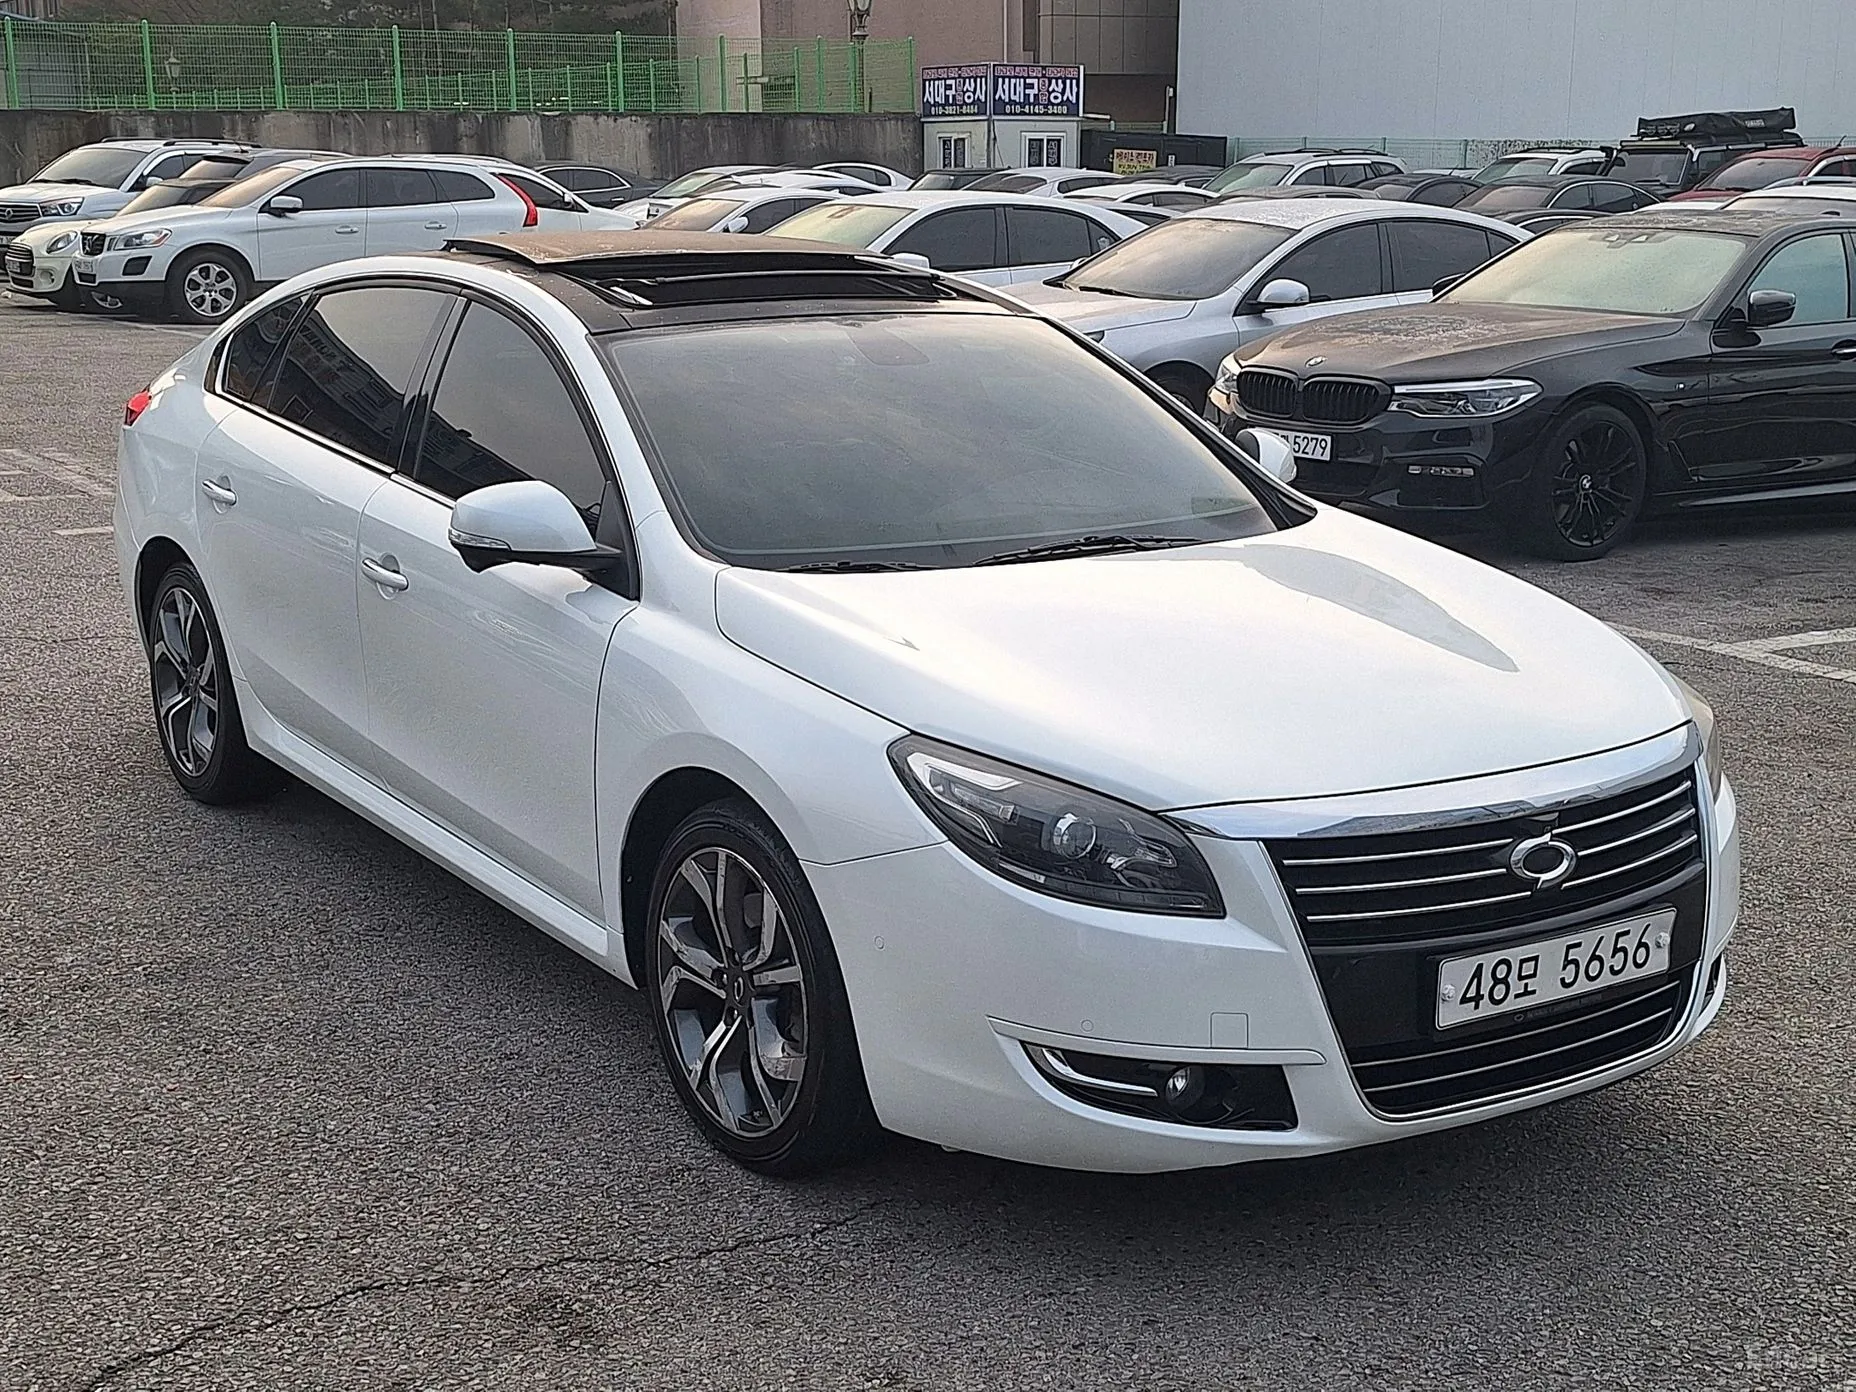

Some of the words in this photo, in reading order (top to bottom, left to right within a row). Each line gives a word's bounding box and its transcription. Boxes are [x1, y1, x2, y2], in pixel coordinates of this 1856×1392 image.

[1292, 435, 1328, 457] 5279
[1458, 954, 1540, 1011] 48모
[1559, 923, 1652, 989] 5656
